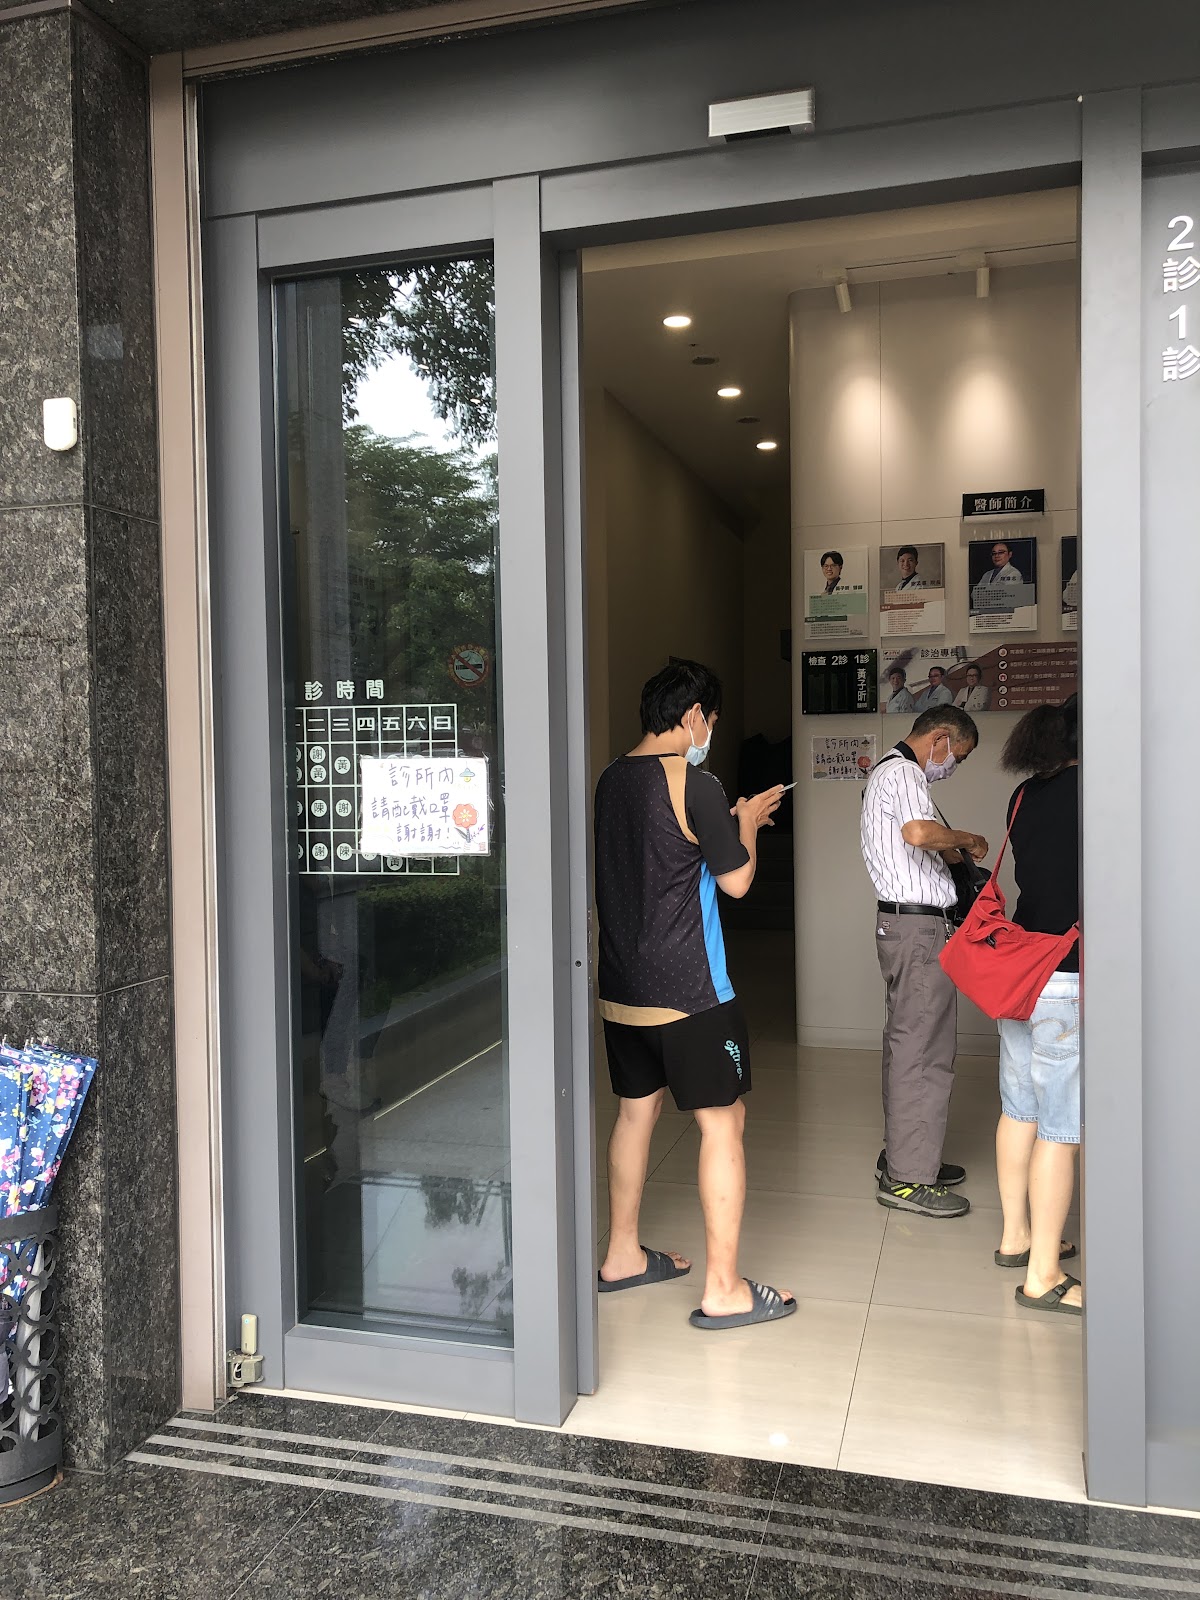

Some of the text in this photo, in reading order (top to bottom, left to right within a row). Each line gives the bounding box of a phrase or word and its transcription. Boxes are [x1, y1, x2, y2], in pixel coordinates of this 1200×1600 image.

[974, 495, 1033, 512] 醫師簡介
[808, 656, 827, 666] 檢查
[831, 654, 848, 666] 2診
[854, 653, 870, 664] 1診
[304, 679, 385, 701] 診時間
[389, 763, 454, 790] 診所內
[371, 792, 451, 823] 請配戴口罩
